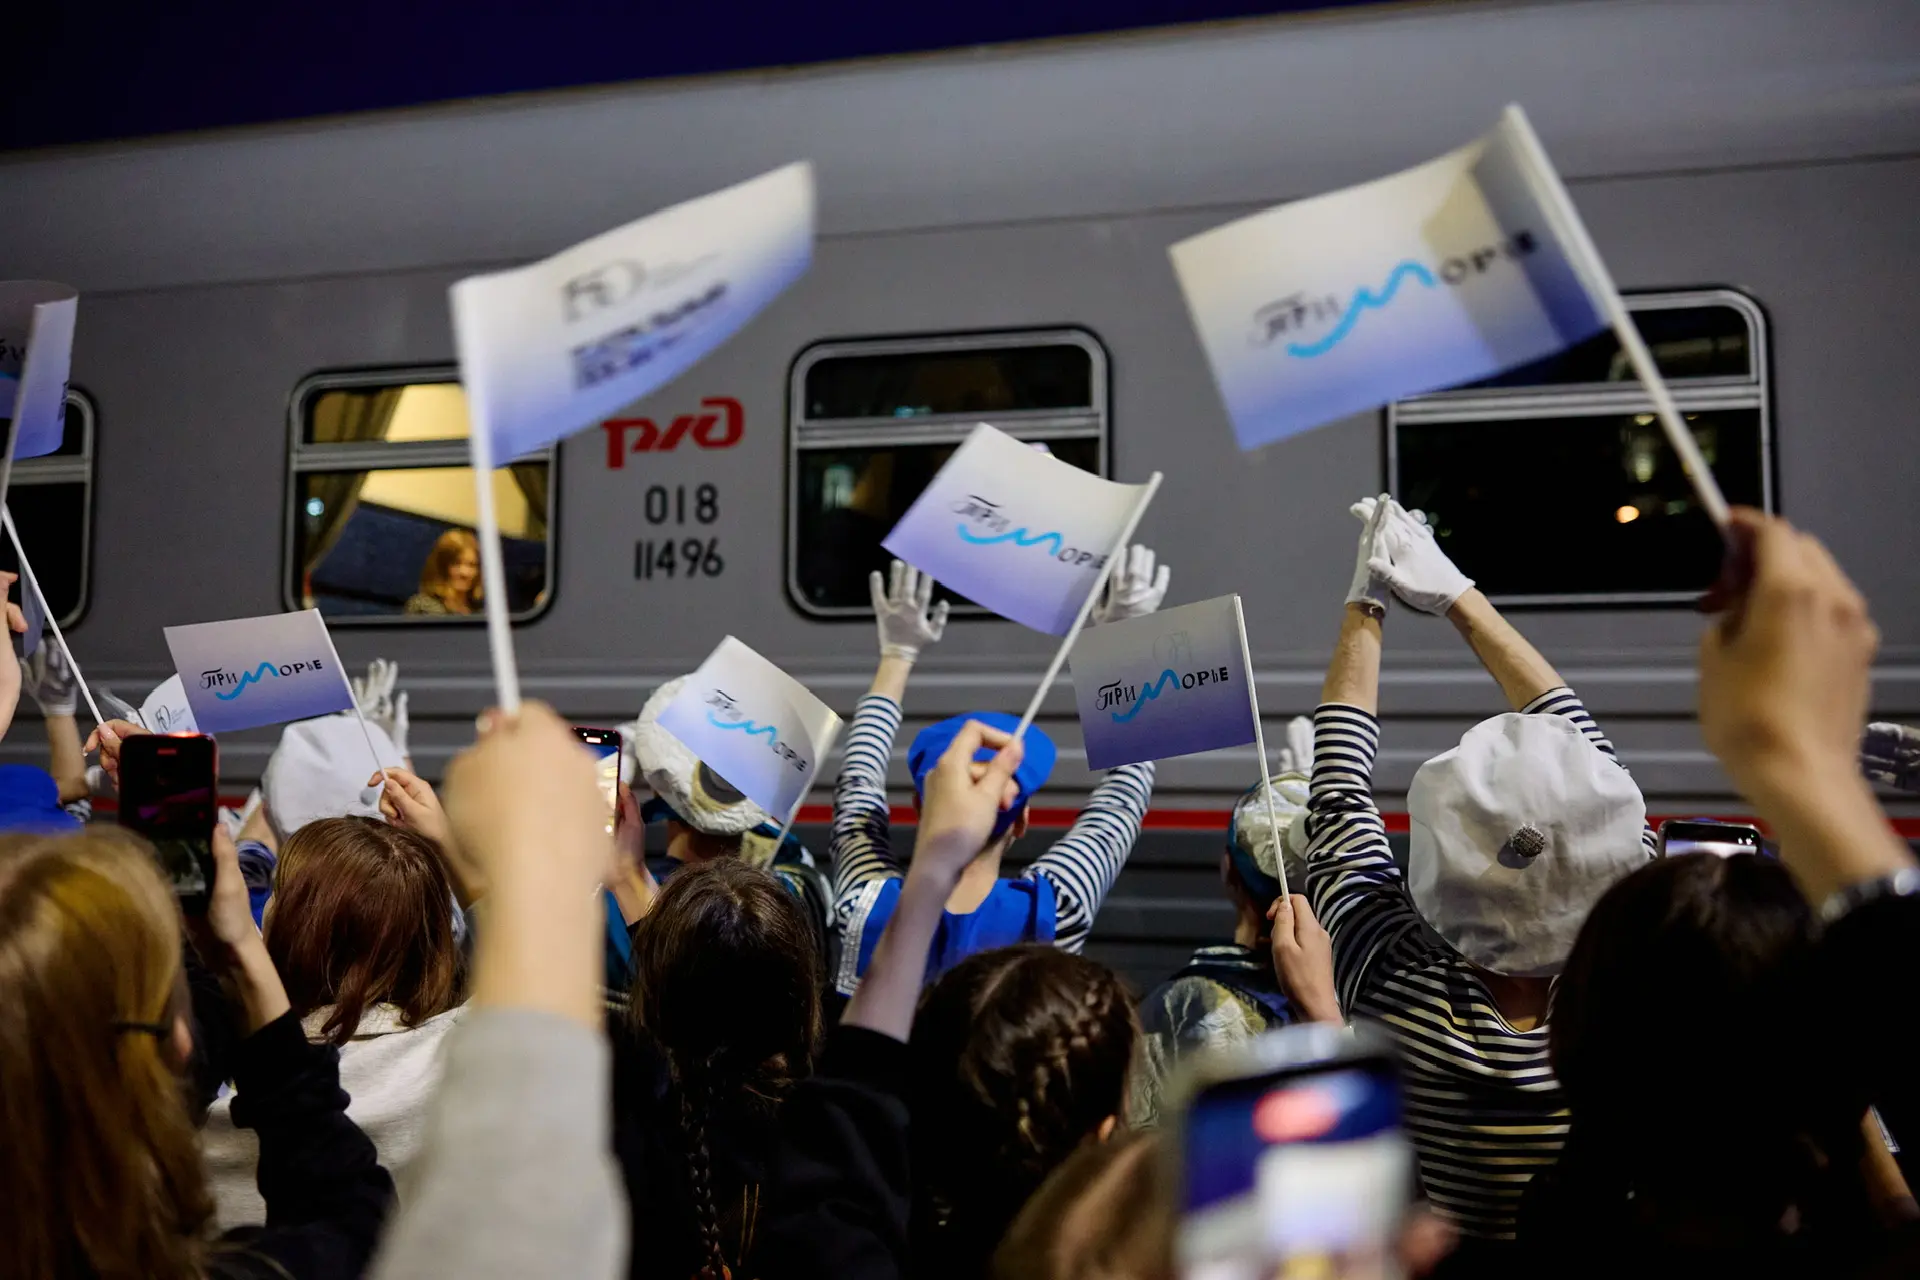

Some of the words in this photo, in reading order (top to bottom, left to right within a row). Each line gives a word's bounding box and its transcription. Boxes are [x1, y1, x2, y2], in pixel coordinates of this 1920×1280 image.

[644, 483, 719, 525] 018
[634, 535, 725, 581] 11496
[199, 659, 323, 701] ПРИМОРЬЕ
[1095, 667, 1229, 723] ПРИМОРЬЕ
